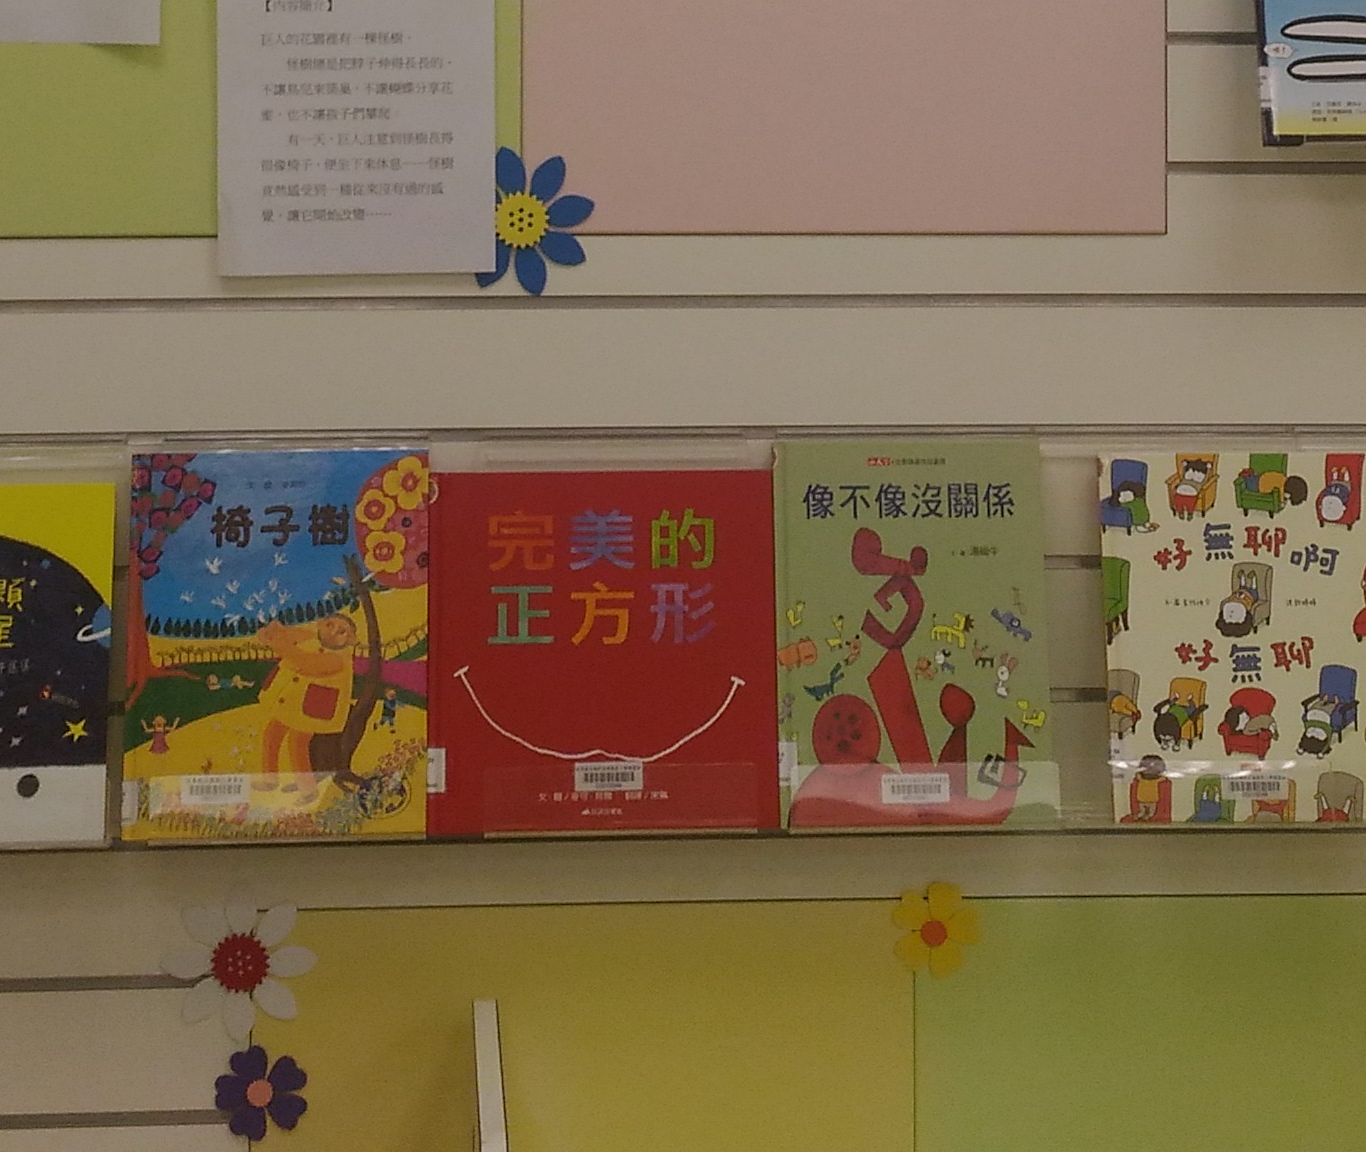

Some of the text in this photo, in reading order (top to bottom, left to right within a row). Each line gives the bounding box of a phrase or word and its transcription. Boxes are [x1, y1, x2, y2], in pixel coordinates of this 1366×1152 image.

[210, 503, 350, 548] 椅子樹
[802, 482, 1016, 520] 像不像沒關係
[487, 507, 716, 572] 完美的
[1153, 523, 1340, 576] 好無聊啊
[487, 581, 716, 645] 正方形
[1174, 636, 1315, 684] 好無聊
